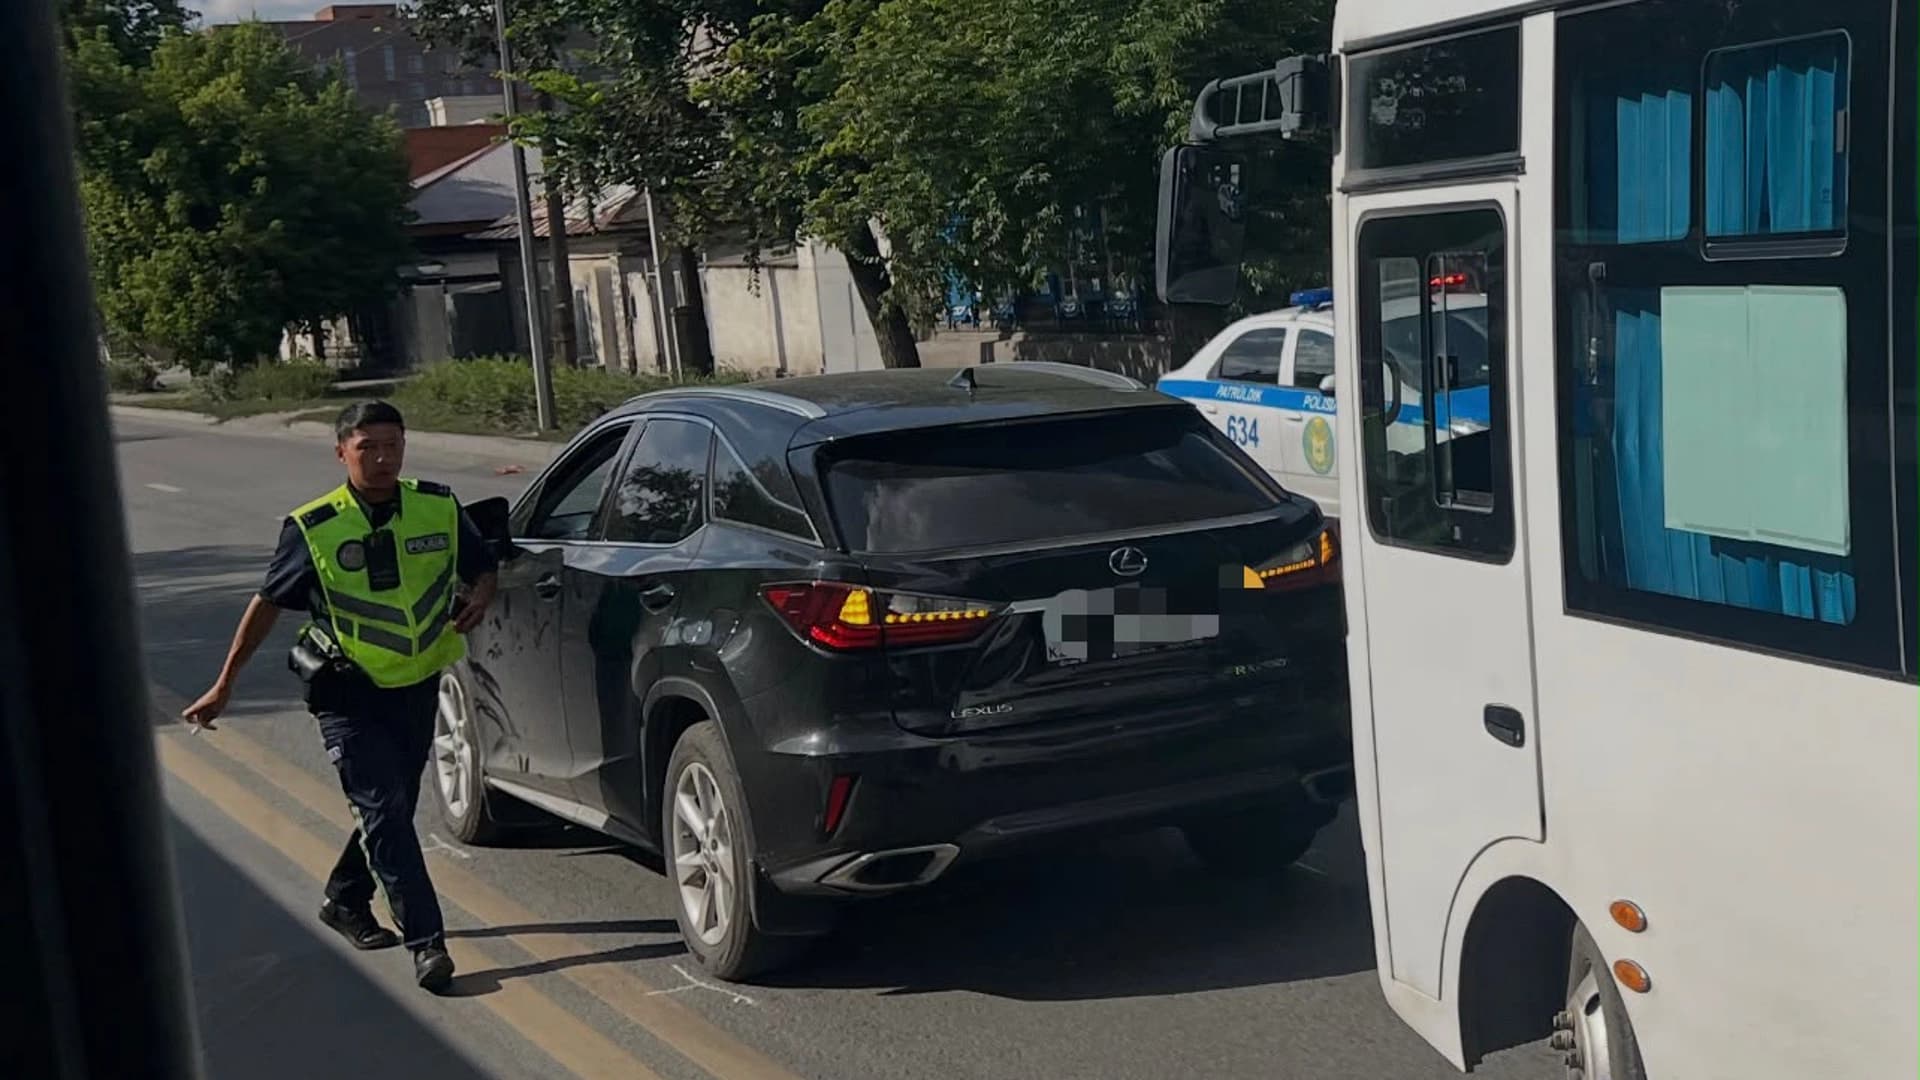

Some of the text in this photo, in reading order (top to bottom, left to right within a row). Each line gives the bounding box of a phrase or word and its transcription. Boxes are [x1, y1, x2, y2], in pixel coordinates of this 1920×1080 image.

[1302, 395, 1336, 411] POLISI
[1227, 415, 1259, 448] 634
[951, 704, 1013, 718] LEXUS
